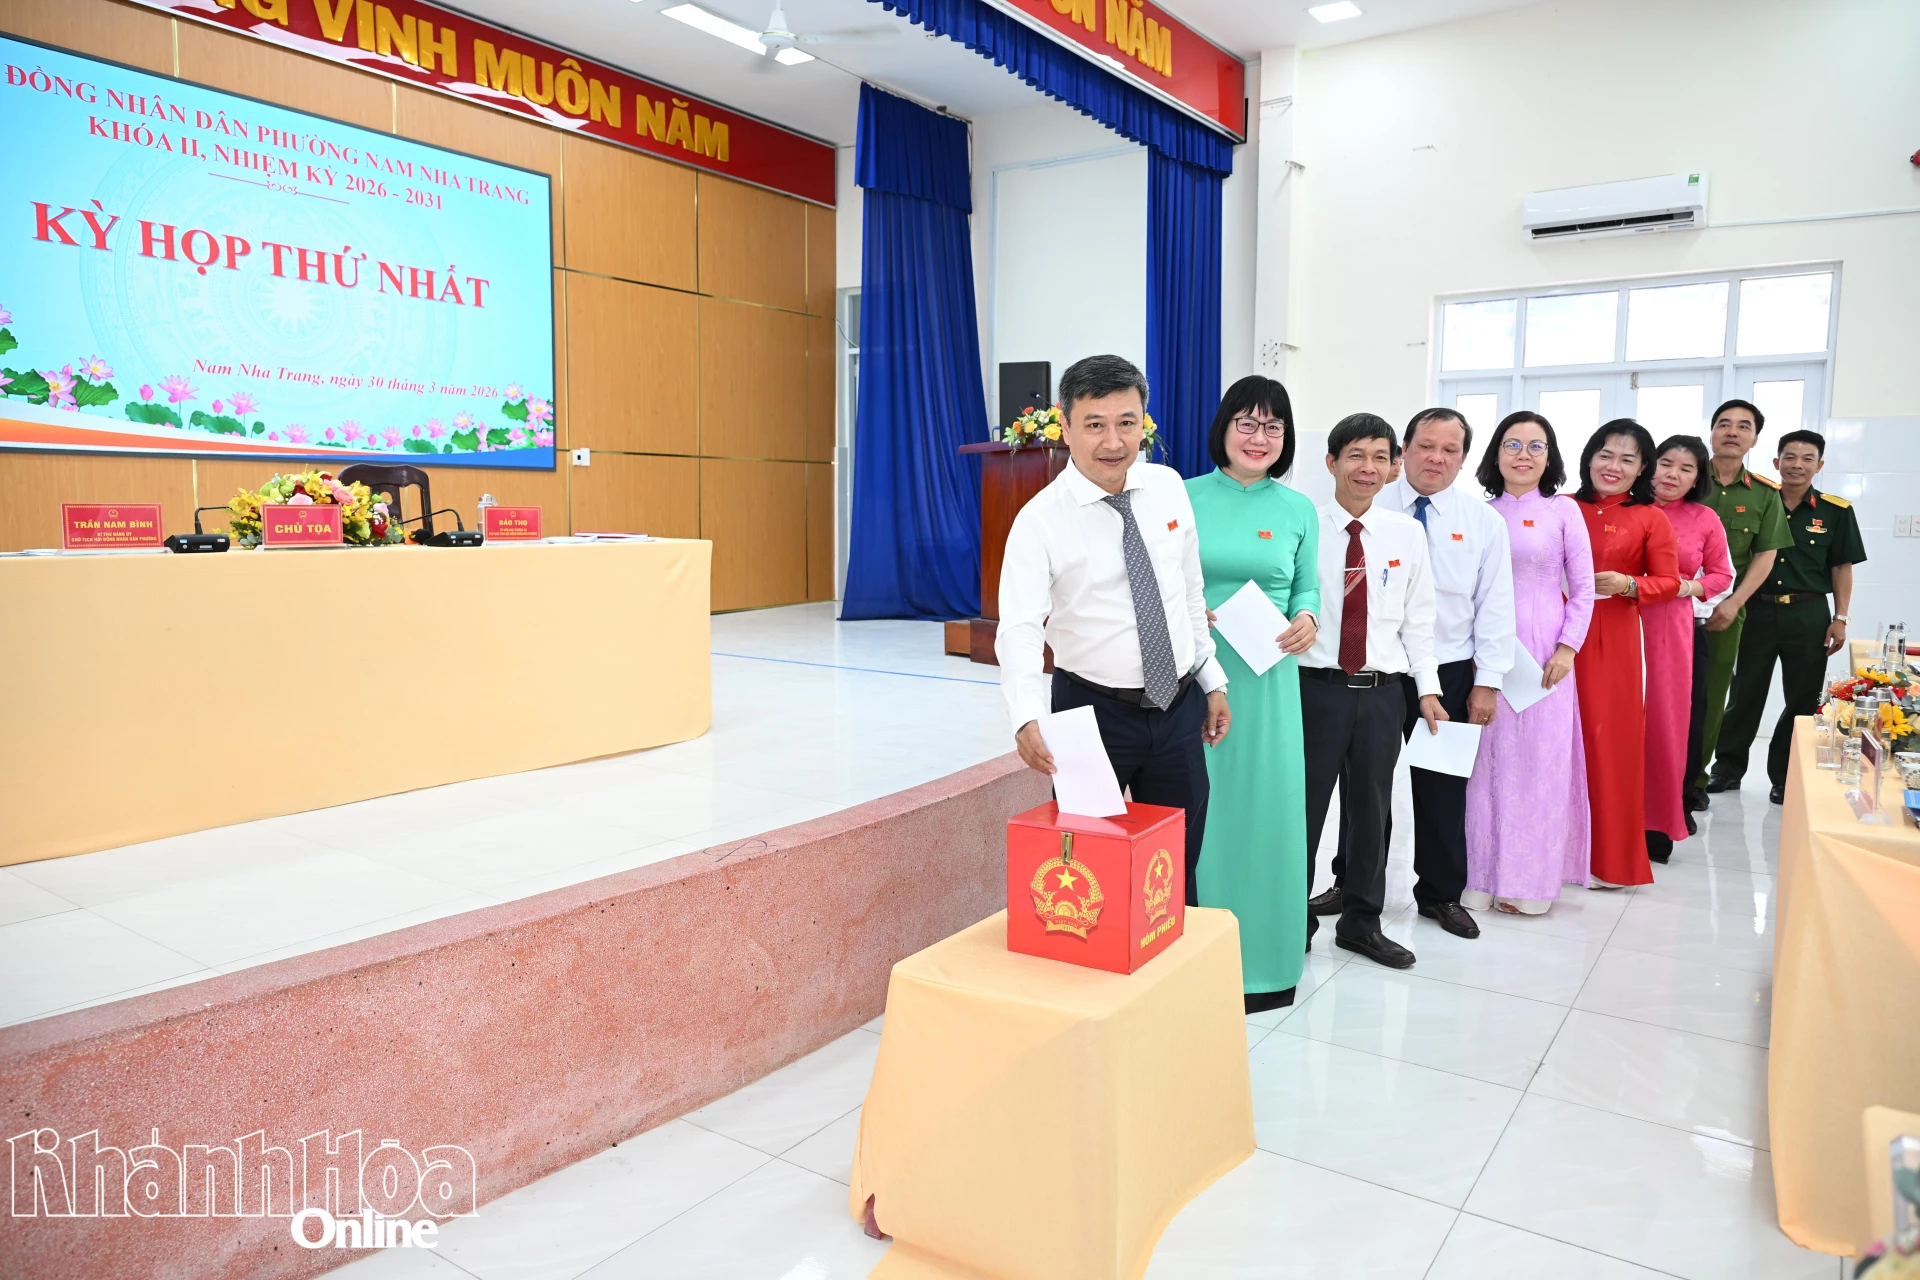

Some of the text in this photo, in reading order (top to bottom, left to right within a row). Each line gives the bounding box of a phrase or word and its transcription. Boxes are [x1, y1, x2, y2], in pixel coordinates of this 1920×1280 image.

[313, 0, 730, 162] VINH MUÔN NĂM
[4, 63, 530, 205] ĐỒNG NHÂN DÂN PHƯỜNG NAM NHA TRANG
[88, 115, 173, 152] KHÓA
[180, 136, 207, 163] II,
[213, 143, 298, 179] NHIỆM
[306, 165, 338, 187] KỲ
[345, 174, 387, 198] 2026
[405, 187, 442, 210] 2031
[29, 199, 490, 309] KỲ HỌP THỨ NHẤT
[193, 359, 498, 399] Nam Nha Trang, ngày 30 tháng 3 năm 2026
[103, 521, 126, 529] NAM
[129, 519, 153, 528] BÌNH
[274, 521, 332, 535] CHỦ TỌA
